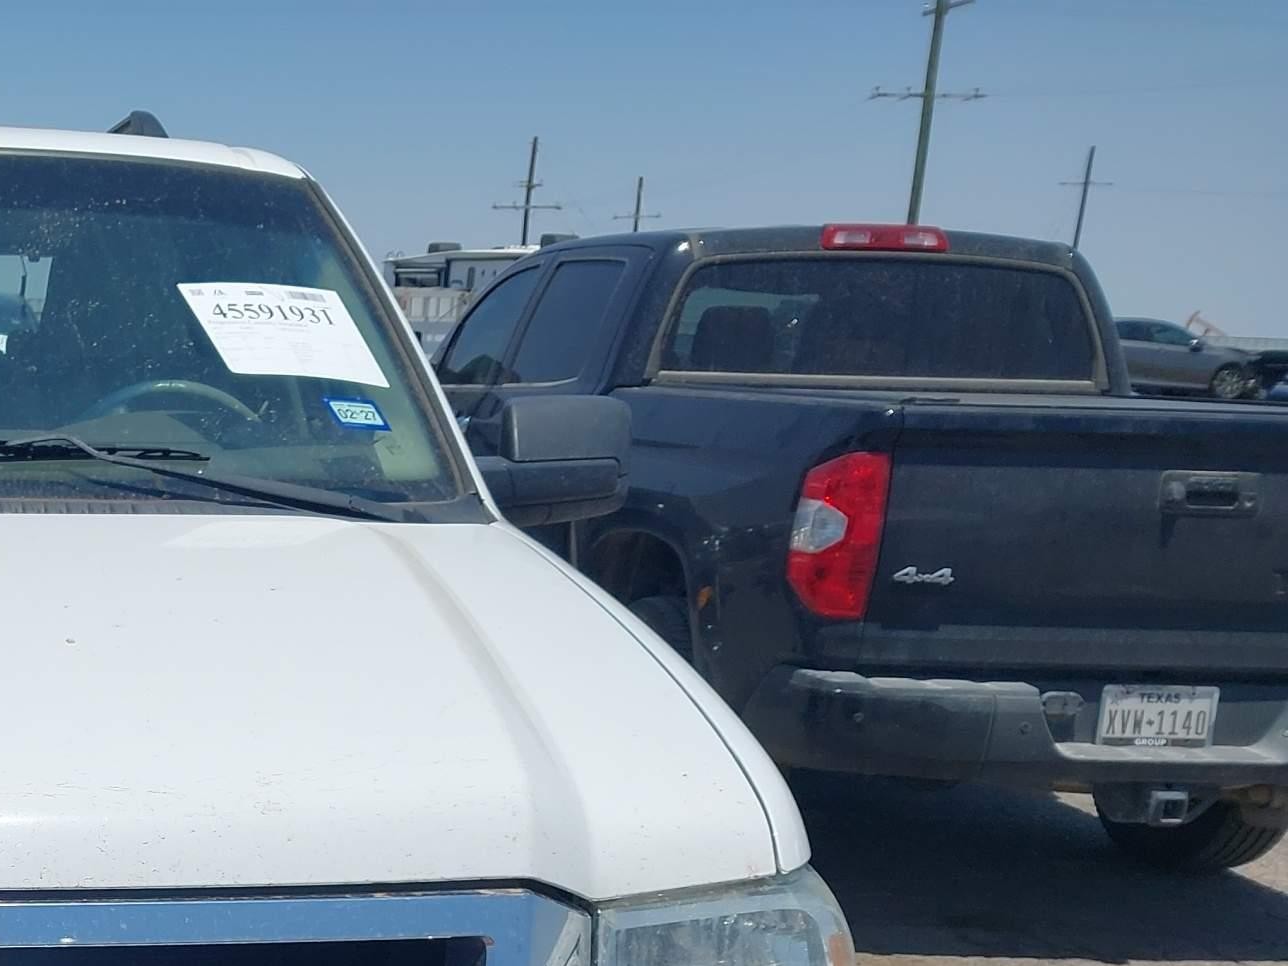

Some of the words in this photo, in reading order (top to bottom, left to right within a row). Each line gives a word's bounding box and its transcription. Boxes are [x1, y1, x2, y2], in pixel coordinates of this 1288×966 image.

[212, 303, 334, 326] 45591931
[1139, 692, 1181, 704] TEXAS
[1134, 737, 1168, 746] GROUP
